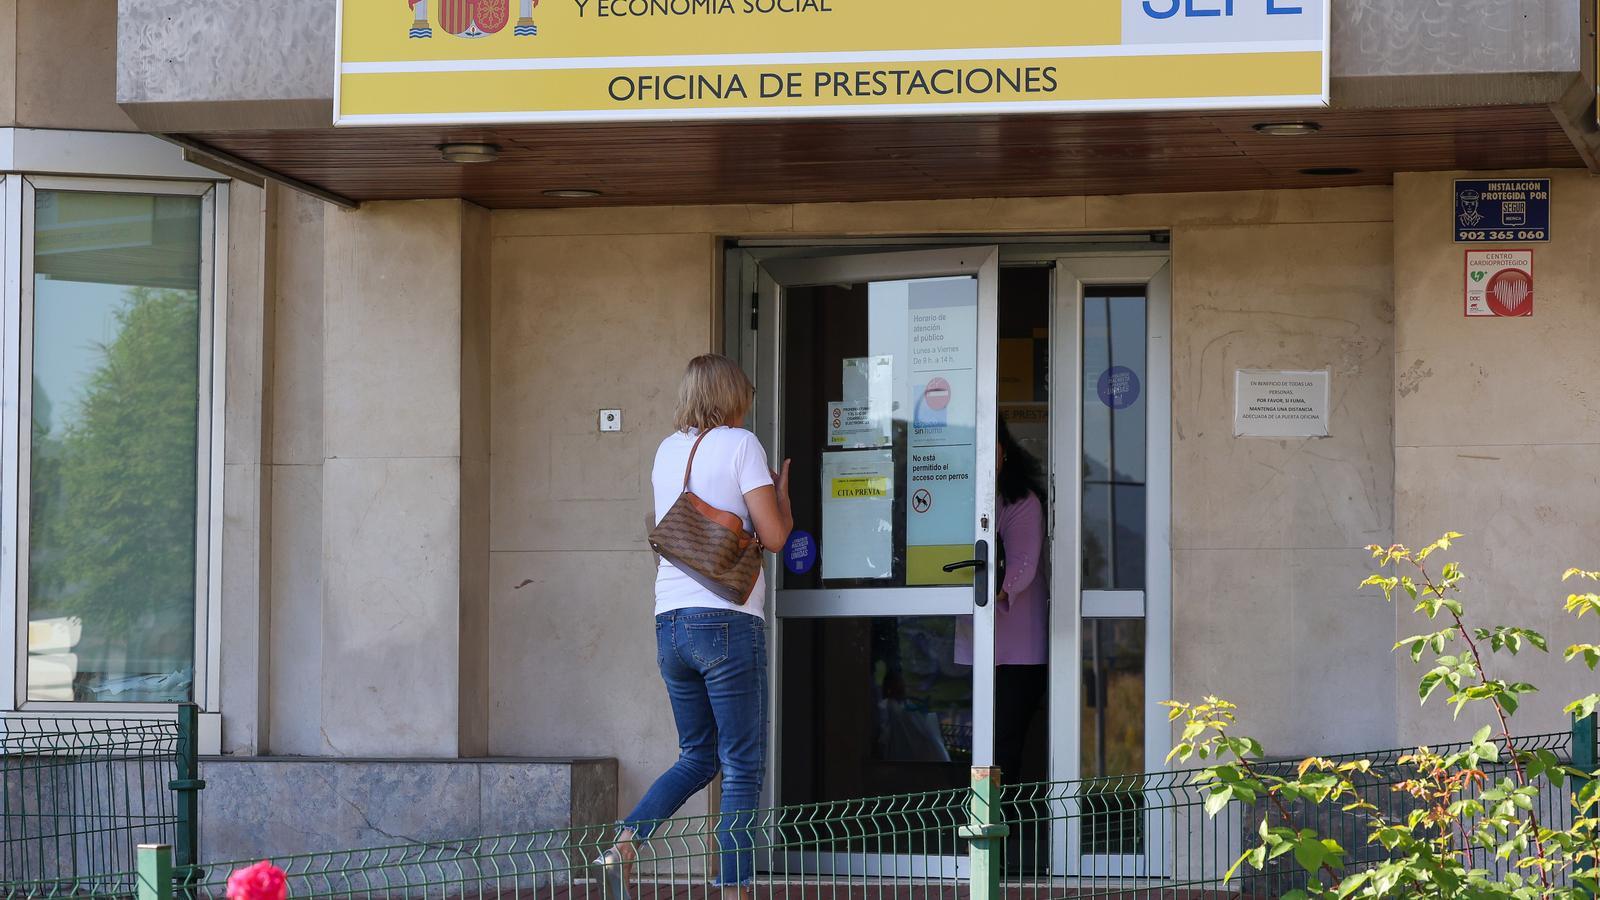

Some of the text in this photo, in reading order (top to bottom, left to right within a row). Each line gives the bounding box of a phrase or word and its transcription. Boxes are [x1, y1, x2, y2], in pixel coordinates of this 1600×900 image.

[574, 0, 585, 18] Y
[743, 0, 833, 14] SOCIAL
[608, 66, 1057, 101] OFICINA DE PRESTACIONES
[1481, 192, 1548, 200] PROTEGIDA POR
[1503, 202, 1525, 212] SEGUR
[1459, 230, 1545, 241] 902 365 060
[913, 314, 937, 323] Horario
[920, 334, 944, 343] público
[937, 345, 959, 353] Viernes
[912, 463, 949, 473] permitido el
[948, 473, 969, 482] perros
[837, 488, 881, 497] CITA PREVIA
